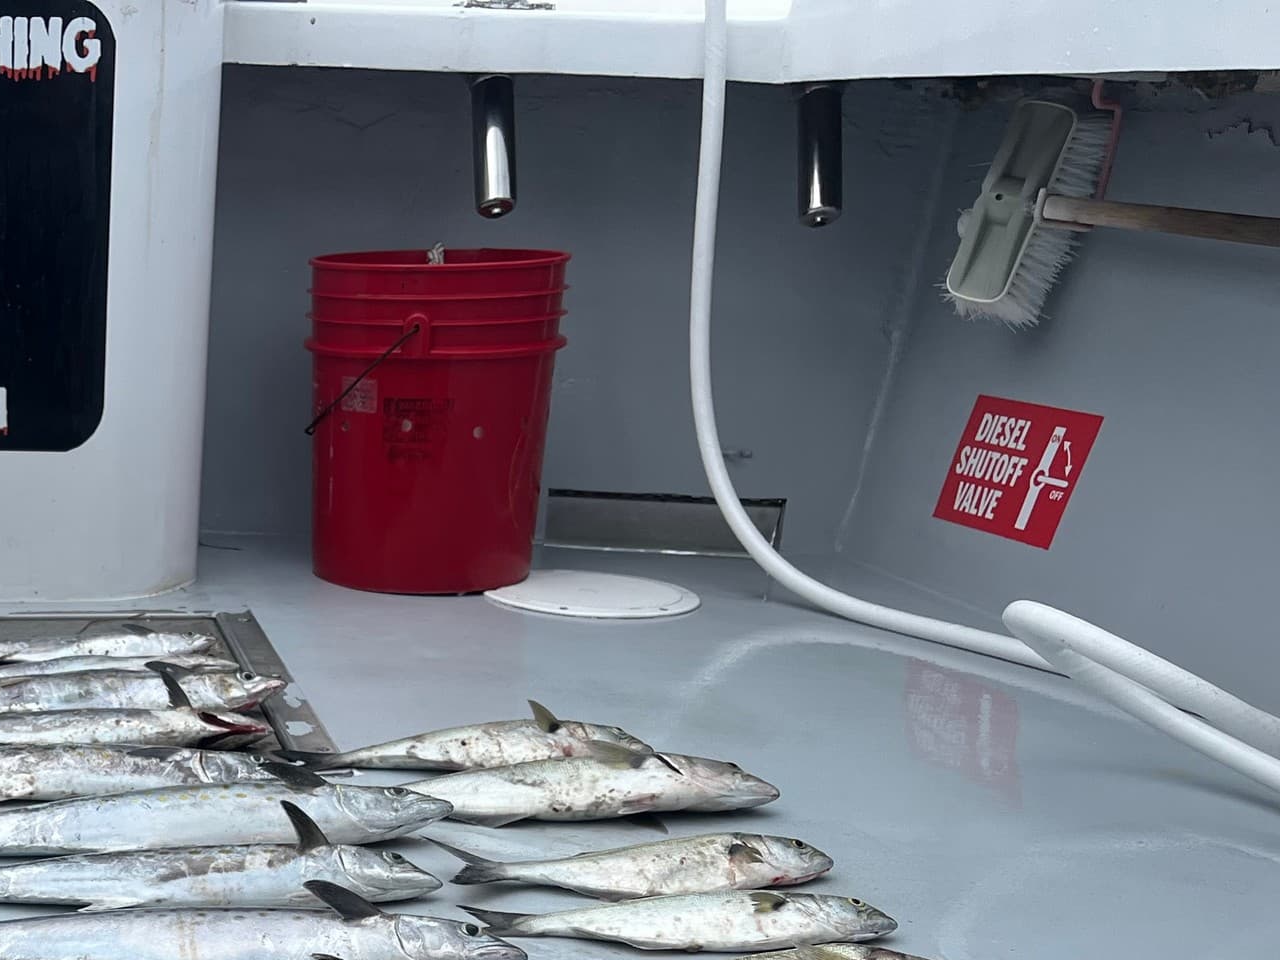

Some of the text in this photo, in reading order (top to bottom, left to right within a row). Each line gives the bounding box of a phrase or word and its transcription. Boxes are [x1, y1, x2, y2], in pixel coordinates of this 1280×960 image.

[974, 412, 1032, 451] DIESEL
[955, 445, 1028, 487] SHUTOFF
[953, 481, 1003, 519] VALVE
[1049, 490, 1064, 501] OFF
